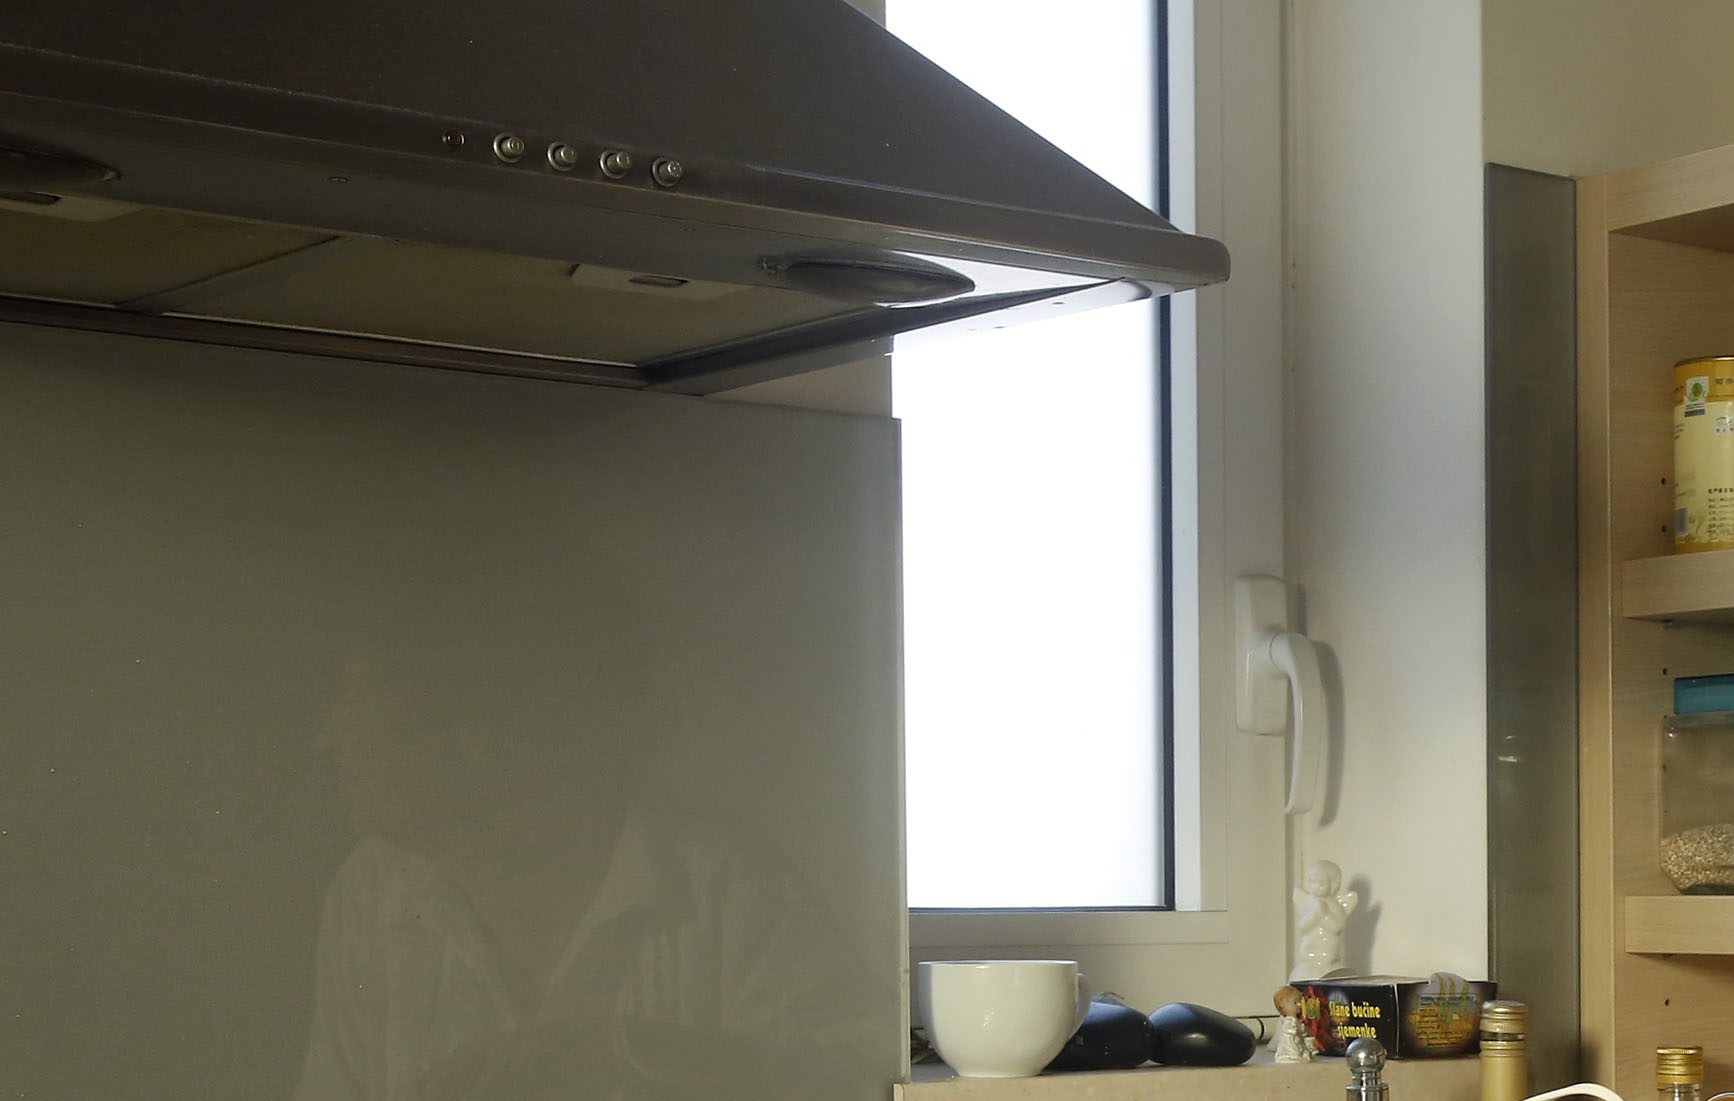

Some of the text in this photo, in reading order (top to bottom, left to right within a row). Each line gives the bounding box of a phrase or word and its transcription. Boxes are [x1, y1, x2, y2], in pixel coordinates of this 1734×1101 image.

[1328, 1000, 1351, 1018] Slane
[1350, 1001, 1381, 1019] bučine
[1337, 1022, 1377, 1040] sjemenke
